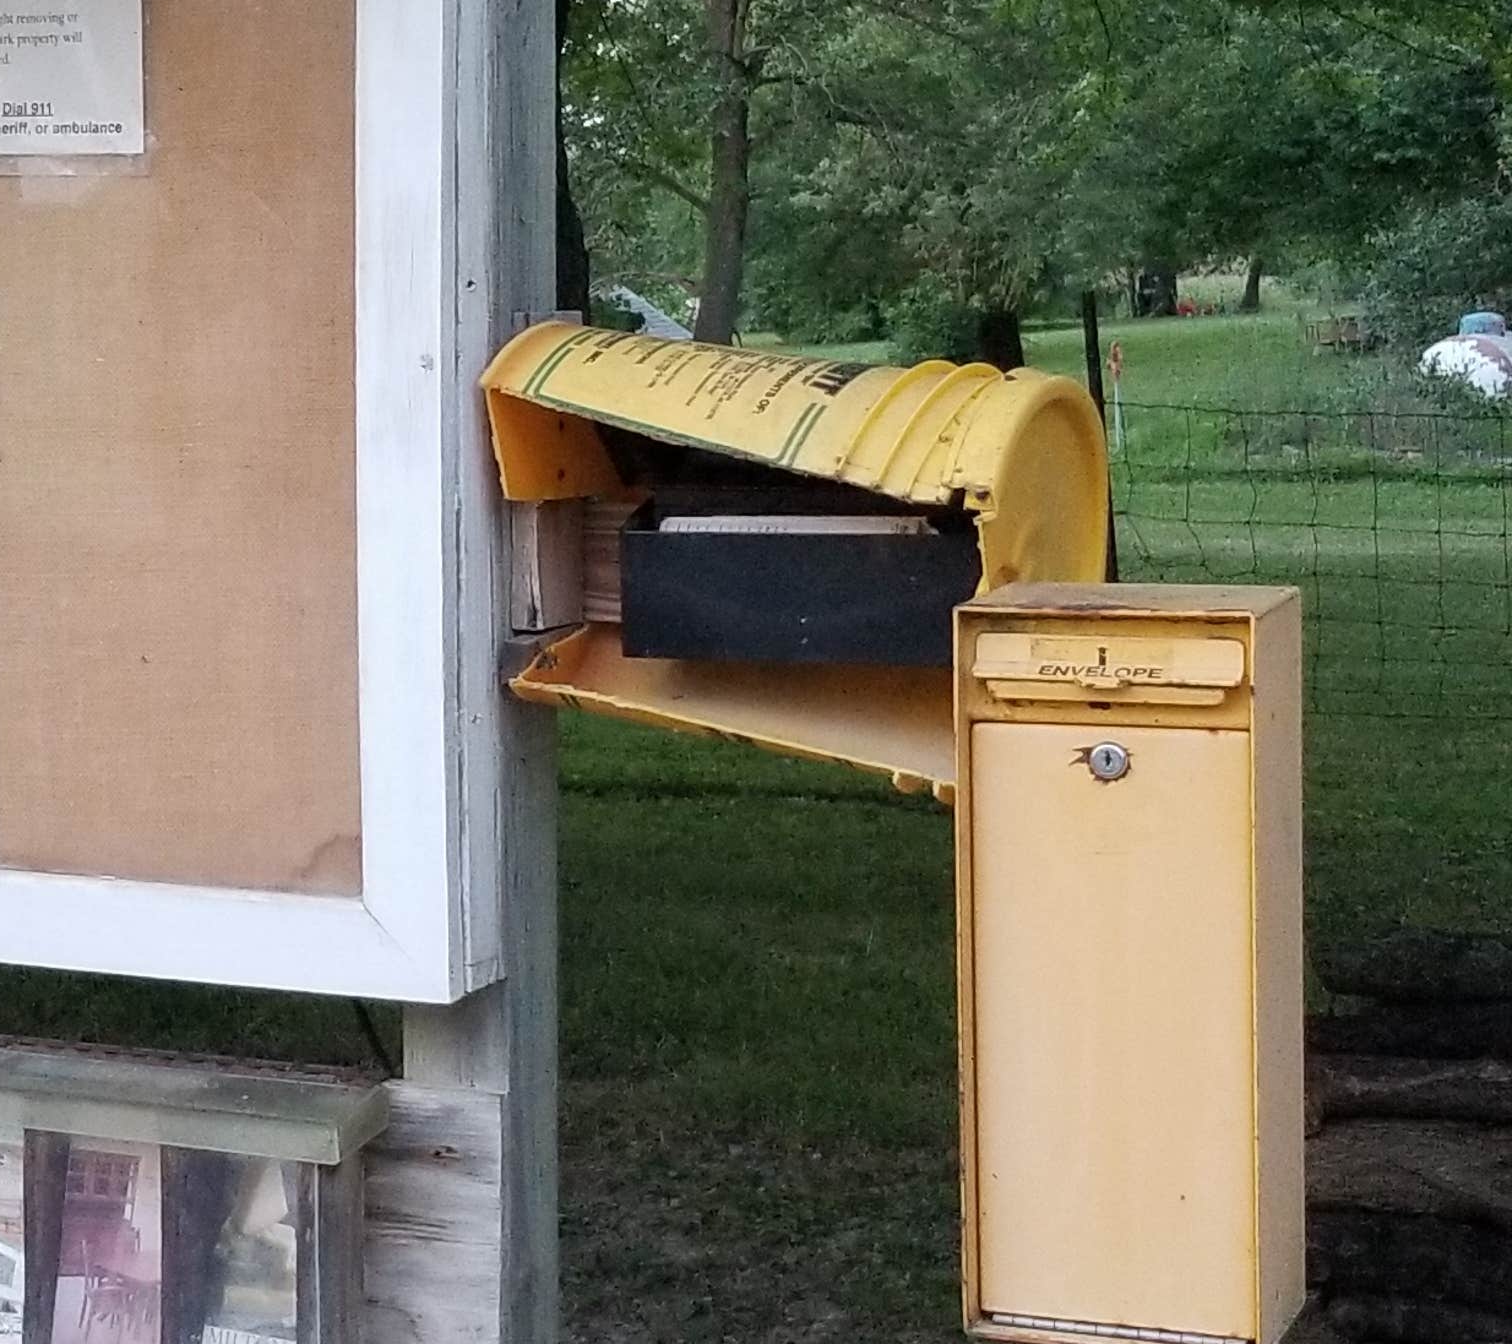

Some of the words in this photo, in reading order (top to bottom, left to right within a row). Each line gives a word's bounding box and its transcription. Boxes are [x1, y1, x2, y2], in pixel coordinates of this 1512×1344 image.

[1, 102, 28, 117] Dial
[31, 102, 53, 116] 911
[35, 124, 49, 135] or
[52, 121, 122, 135] ambulance
[1038, 664, 1164, 679] ENVELOPE
